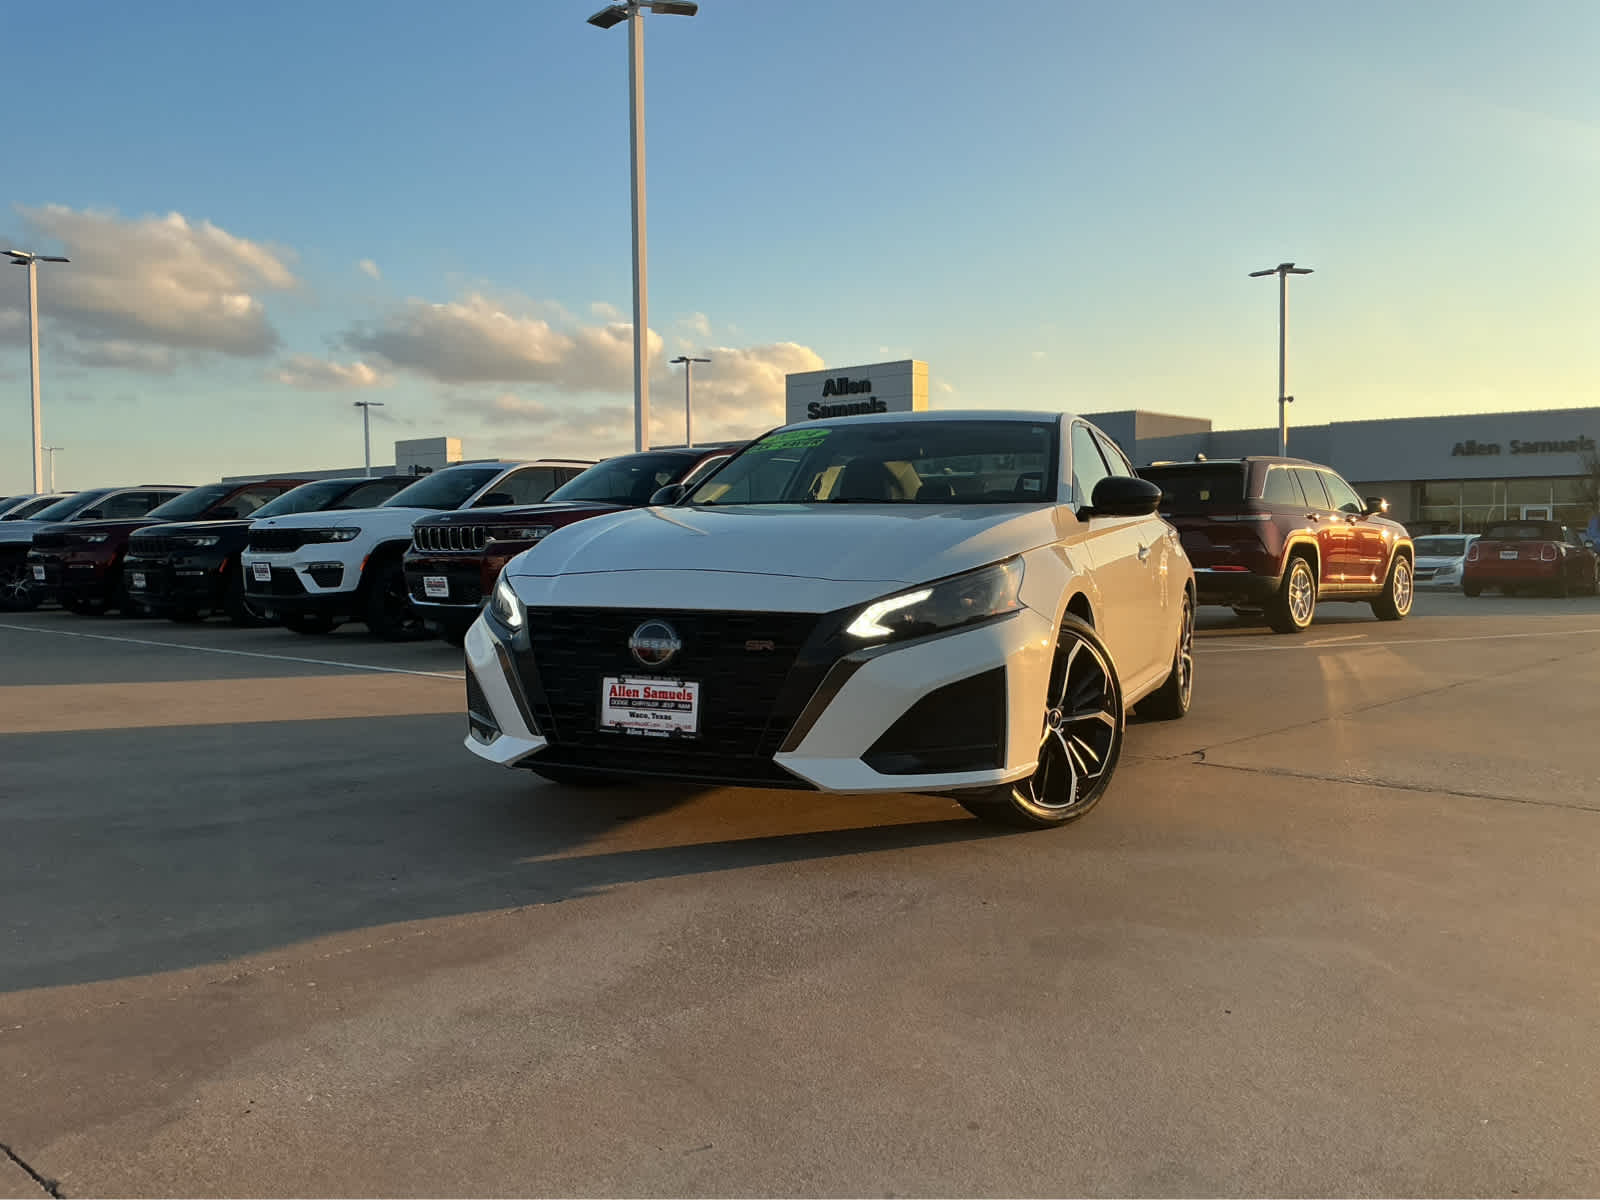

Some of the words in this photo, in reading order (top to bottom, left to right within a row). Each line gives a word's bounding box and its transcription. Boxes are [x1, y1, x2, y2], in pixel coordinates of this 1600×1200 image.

[822, 377, 872, 397] Allen
[807, 396, 888, 420] Samuels
[1451, 439, 1501, 457] Allen
[1509, 434, 1596, 455] Samuels
[628, 638, 681, 650] NISSAN
[609, 684, 640, 698] Allen
[643, 686, 693, 700] Samuels
[628, 711, 650, 720] Waco,
[651, 712, 672, 721] Texas
